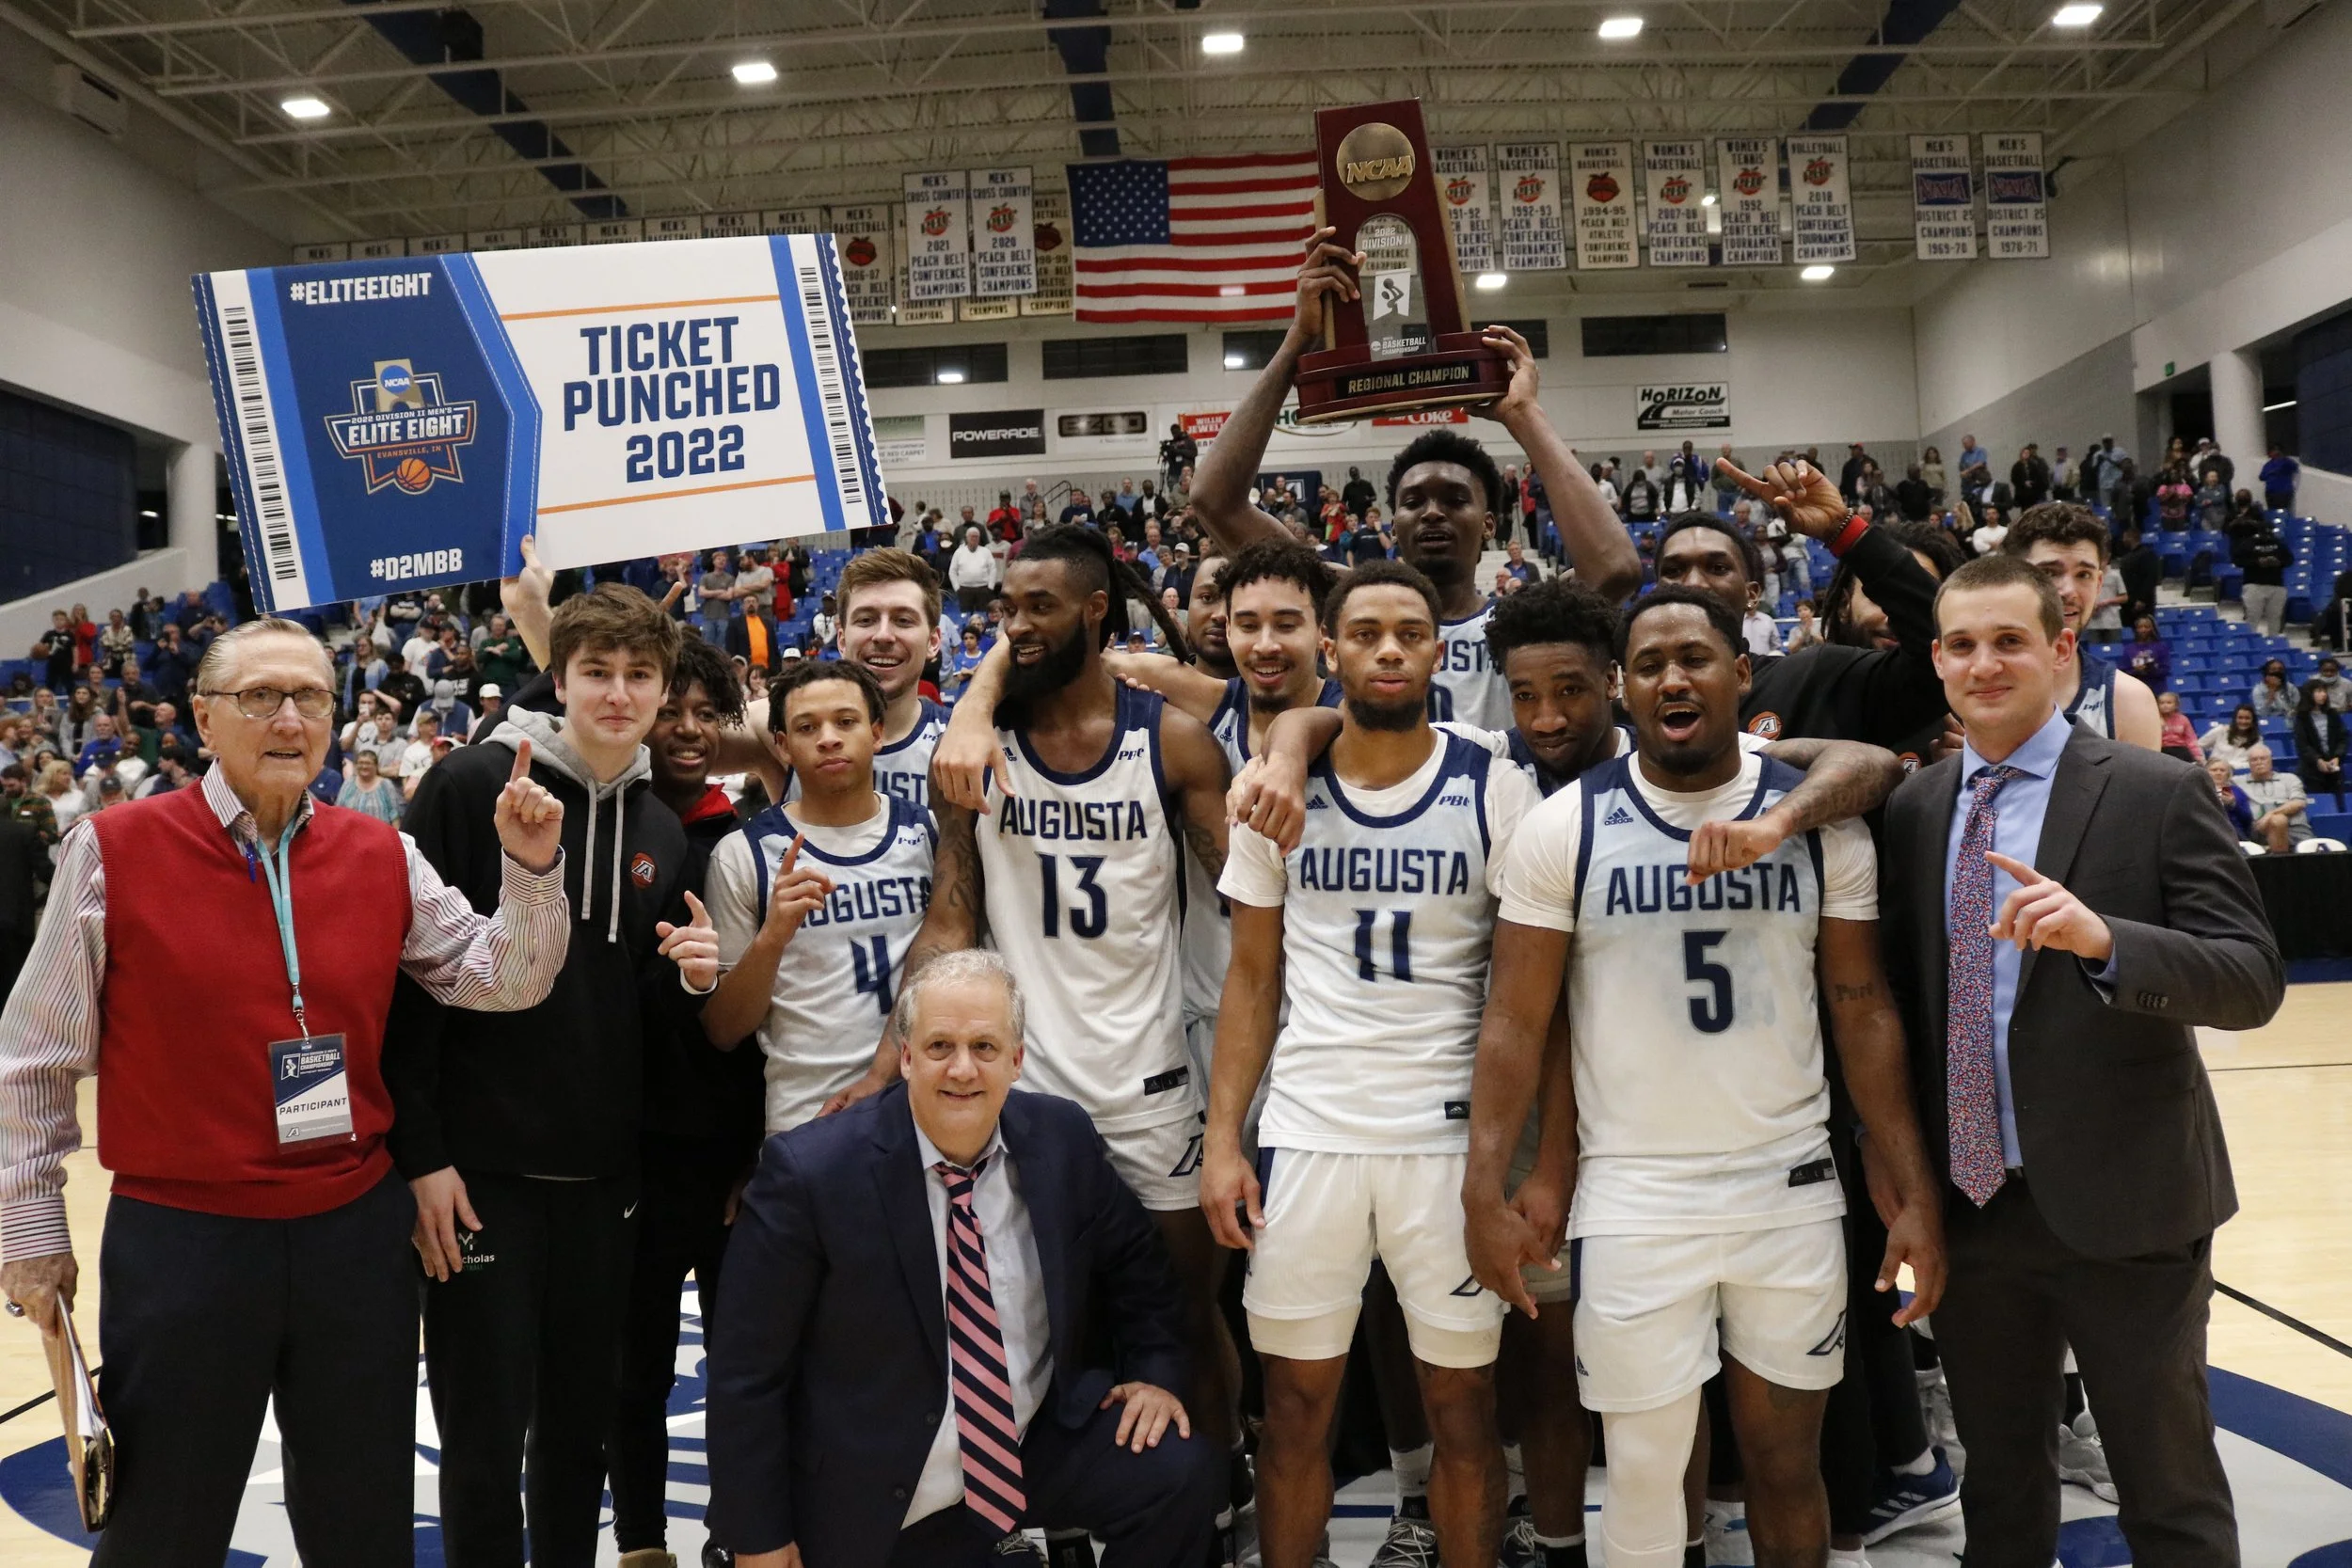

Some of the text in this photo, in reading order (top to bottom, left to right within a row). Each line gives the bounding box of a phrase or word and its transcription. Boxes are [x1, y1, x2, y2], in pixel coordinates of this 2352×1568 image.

[1653, 144, 1694, 155] WOMEN'S
[1726, 140, 1769, 152] WOMEN'S
[1791, 142, 1843, 154] VOLLEYBALL
[1926, 140, 1954, 151] MEN'S
[1998, 138, 2026, 150] MEN'S
[1437, 148, 1477, 160] WOMEN'S
[1506, 146, 1549, 158] WOMEN'S
[1500, 158, 1557, 170] BASKETBALL
[1646, 158, 1702, 170] BASKETBALL
[1731, 153, 1765, 165] TENNIS
[1913, 157, 1969, 169] BASKETBALL
[1986, 154, 2041, 166] BASKETBALL
[1346, 155, 1413, 184] NCAA
[922, 175, 948, 186] MEN'S
[989, 172, 1014, 184] MEN'S
[1512, 205, 1552, 216] 1992-93
[1739, 199, 1762, 211] 1992
[1795, 204, 1848, 216] PEACH BELT
[846, 208, 873, 220] MEN'S
[1723, 212, 1751, 223] PEACH
[1916, 210, 1957, 221] DISTRICT
[1988, 209, 2028, 220] DISTRICT
[1502, 217, 1561, 230] PEACH BELT
[1648, 222, 1677, 233] PEACH
[1797, 218, 1849, 230] CONFERENCE
[1503, 230, 1563, 242] CONFERENCE
[1921, 226, 1973, 237] CHAMPIONS
[1993, 225, 2043, 236] CHAMPIONS
[992, 237, 1017, 248] 2020
[1361, 236, 1403, 250] DIVISION
[1650, 236, 1708, 247] CONFERENCE
[1798, 231, 1849, 245] TOURNAMENT
[927, 240, 950, 252] 2021
[1505, 244, 1562, 255] TOURNAMENT
[1798, 245, 1851, 259] CHAMPIONS
[912, 252, 965, 267] PEACH BELT
[977, 248, 1032, 263] PEACH BELT
[1508, 256, 1562, 267] CHAMPIONS
[1588, 254, 1629, 263] CHAMPIONS
[1655, 250, 1706, 262] CHAMPIONS
[1727, 249, 1779, 262] CHAMPIONS
[913, 268, 966, 281] CONFERENCE
[979, 264, 1032, 277] CONFERENCE
[290, 272, 432, 305] #ELITEEIGHT
[914, 283, 965, 296] CHAMPIONS
[982, 278, 1032, 293] CHAMPIONS
[851, 310, 887, 323] AMPIONS
[580, 316, 739, 375] TICKET
[1382, 337, 1426, 349] BASKETBALL
[1381, 346, 1420, 356] CHAMPIONSHIP
[384, 379, 410, 388] NCAA
[1348, 366, 1470, 393] REGIONAL CHAMPION
[564, 363, 780, 431] PUNCHED
[1641, 387, 1721, 404] HORIZON
[351, 416, 373, 424] 2022
[376, 411, 415, 421] DIVISION
[348, 414, 464, 447] ELITE EIGHT
[952, 427, 1040, 442] POWERADE
[377, 447, 430, 458] EVANSVILLE,
[627, 425, 744, 483] 2022
[371, 549, 463, 582] #D2MBB
[999, 796, 1148, 842] AUGUSTA
[1604, 815, 1634, 826] adidas
[1300, 847, 1470, 895] AUGUSTA
[1034, 850, 1109, 940] 13
[1606, 862, 1802, 916] AUGUSTA
[800, 877, 931, 928] UGUSTA
[1352, 907, 1413, 984] 11
[850, 933, 893, 1016] 4
[1681, 927, 1735, 1035] 5
[301, 1052, 341, 1065] BASKETBALL
[279, 1098, 347, 1115] PARTICIPANT
